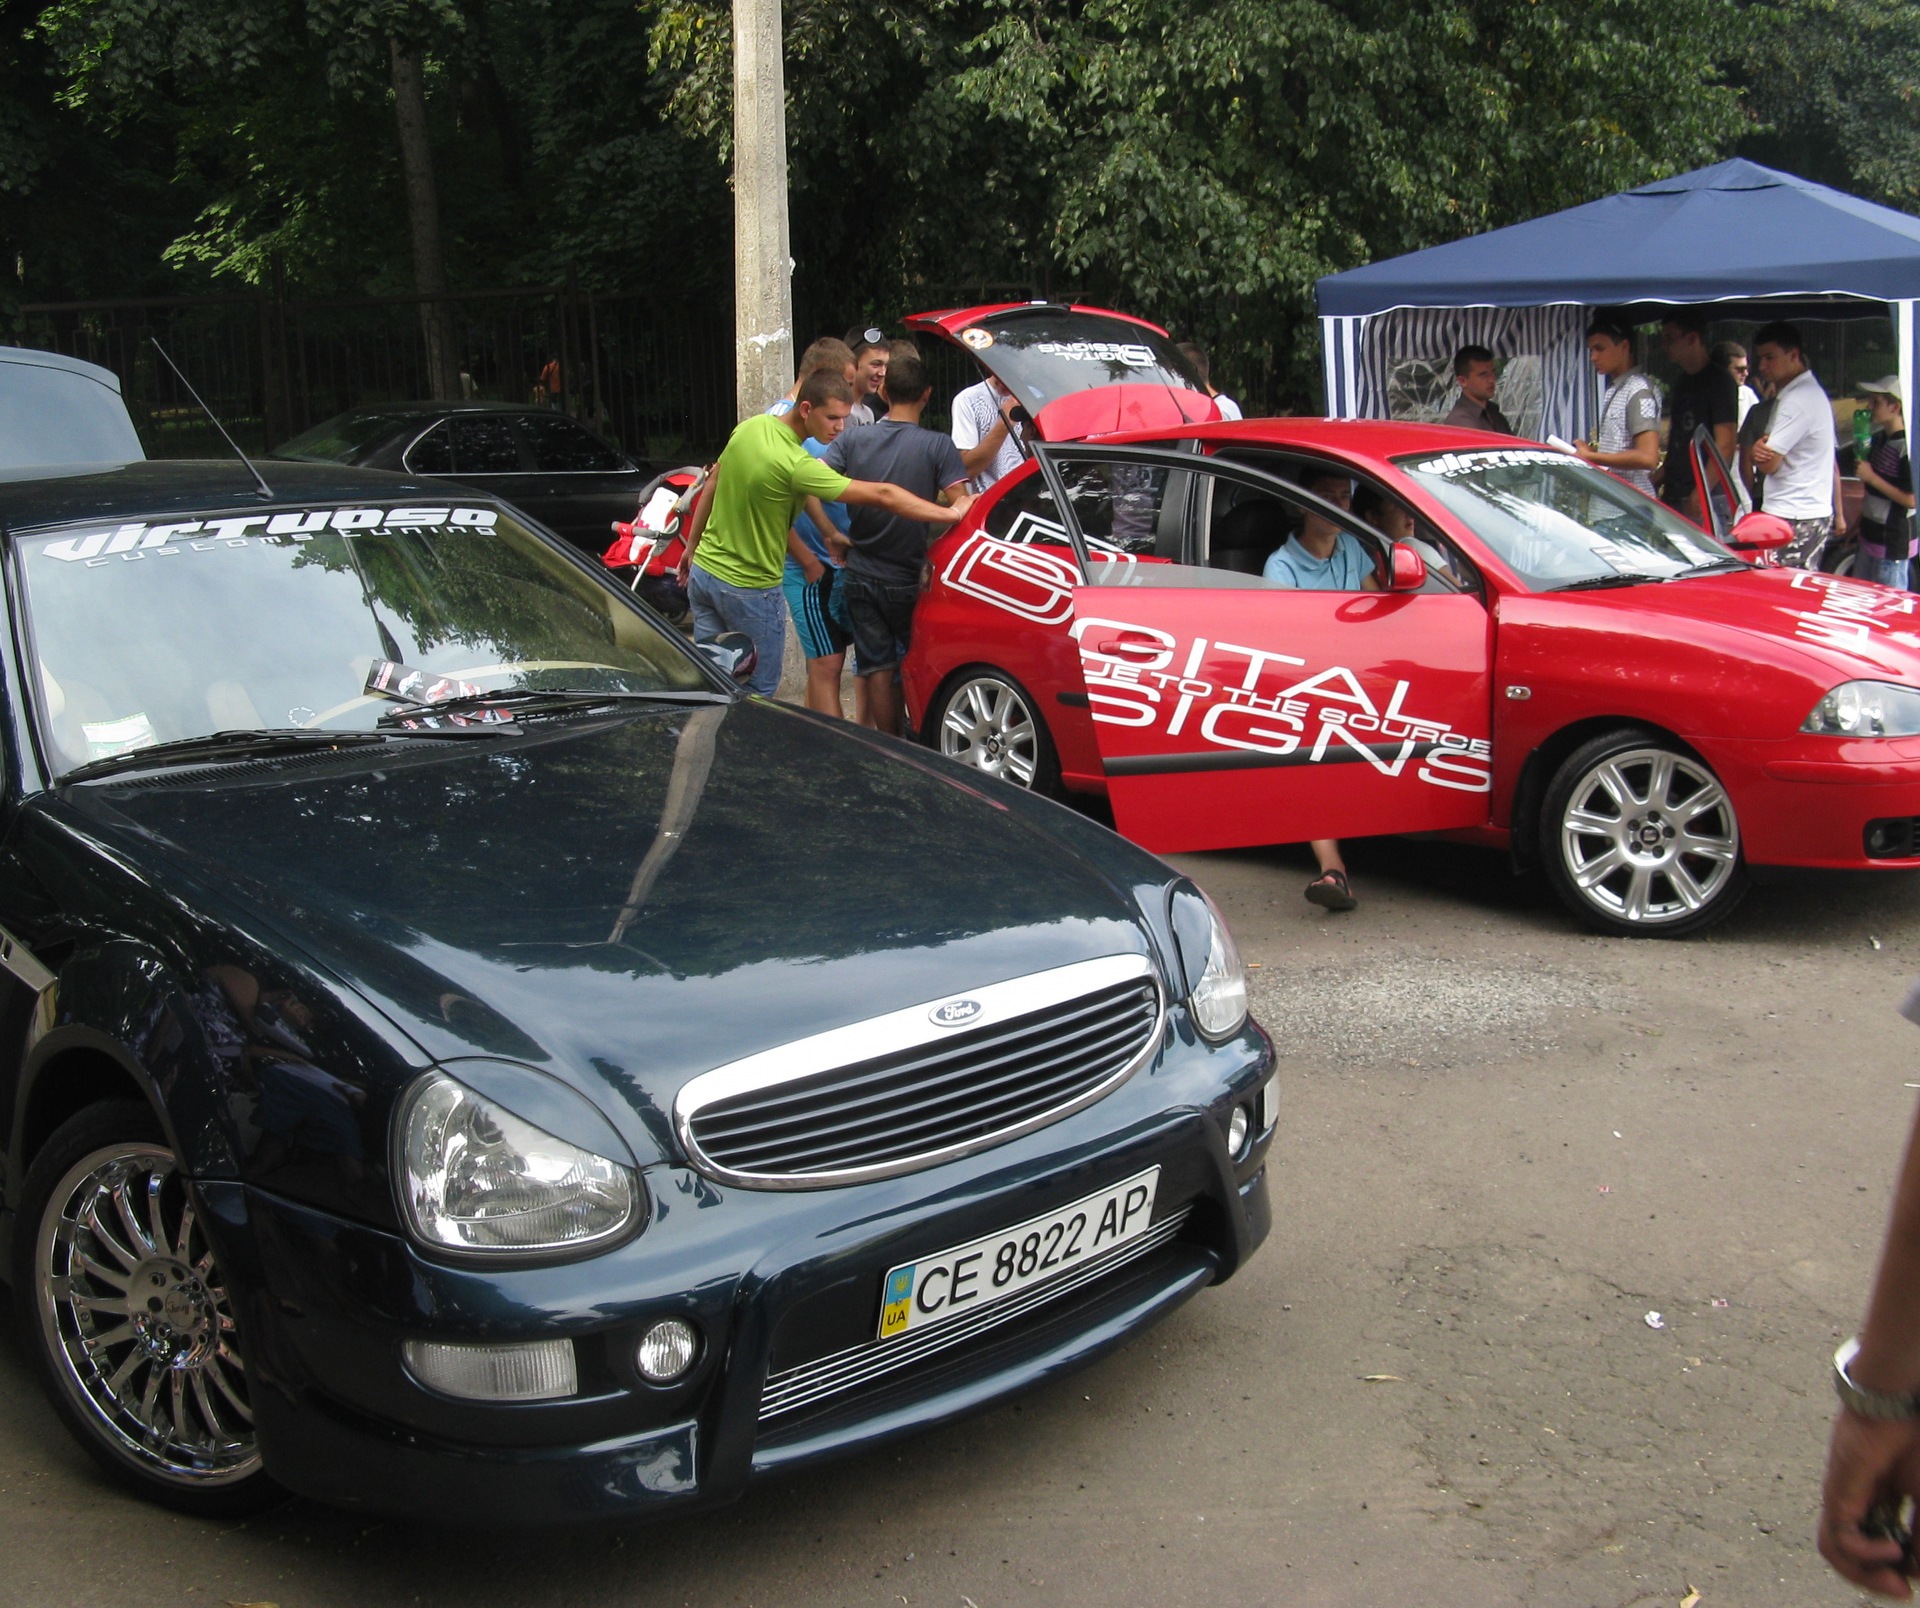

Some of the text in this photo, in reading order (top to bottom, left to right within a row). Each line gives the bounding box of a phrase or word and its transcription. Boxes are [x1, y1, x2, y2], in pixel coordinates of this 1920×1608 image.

[85, 526, 497, 568] customs tuning
[1150, 672, 1213, 697] TO
[1222, 686, 1310, 717] THE
[1318, 707, 1491, 755] SOURCE
[942, 1002, 975, 1021] Ford
[917, 1184, 1148, 1314] CE 8822 AP
[887, 1310, 906, 1326] UA
